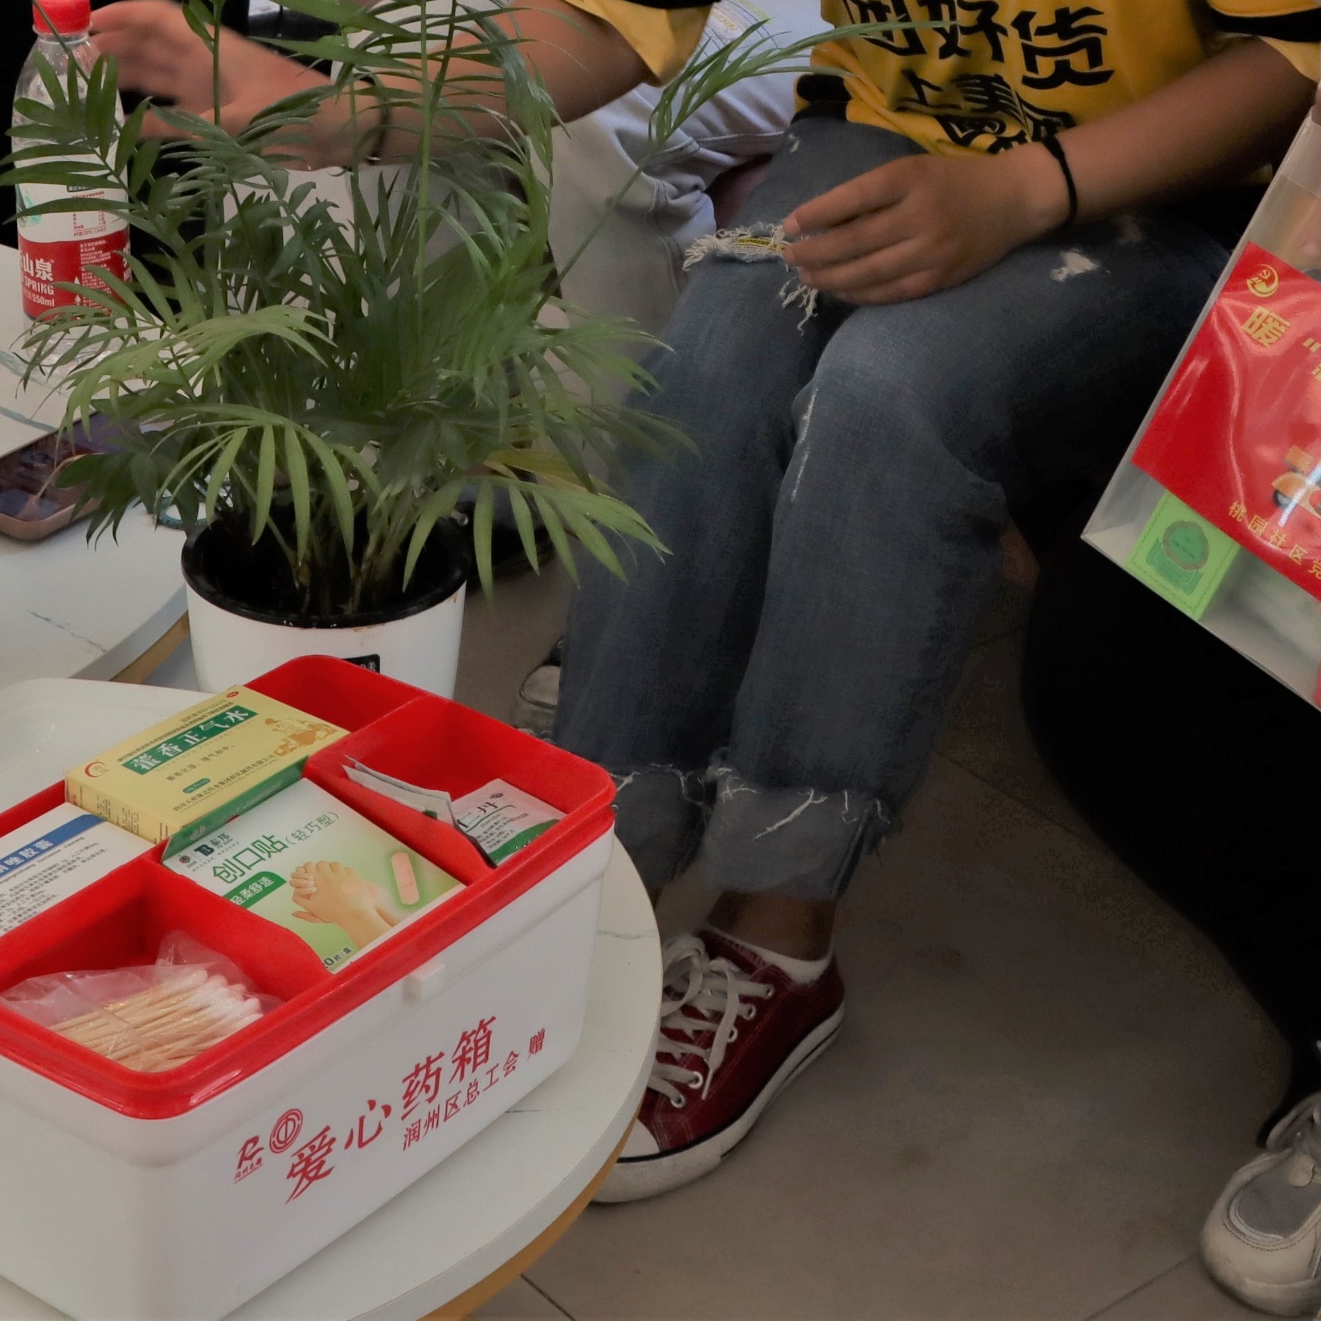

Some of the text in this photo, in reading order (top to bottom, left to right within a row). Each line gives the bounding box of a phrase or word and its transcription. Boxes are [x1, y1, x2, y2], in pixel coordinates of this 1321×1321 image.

[21, 251, 53, 281] 山泉
[131, 709, 250, 773] 藿香正气水
[212, 833, 289, 884] 创口贴
[324, 947, 353, 969] 0片/盒
[285, 1015, 497, 1205] 爱心药箱
[402, 1027, 546, 1151] 润州区总工会 赠
